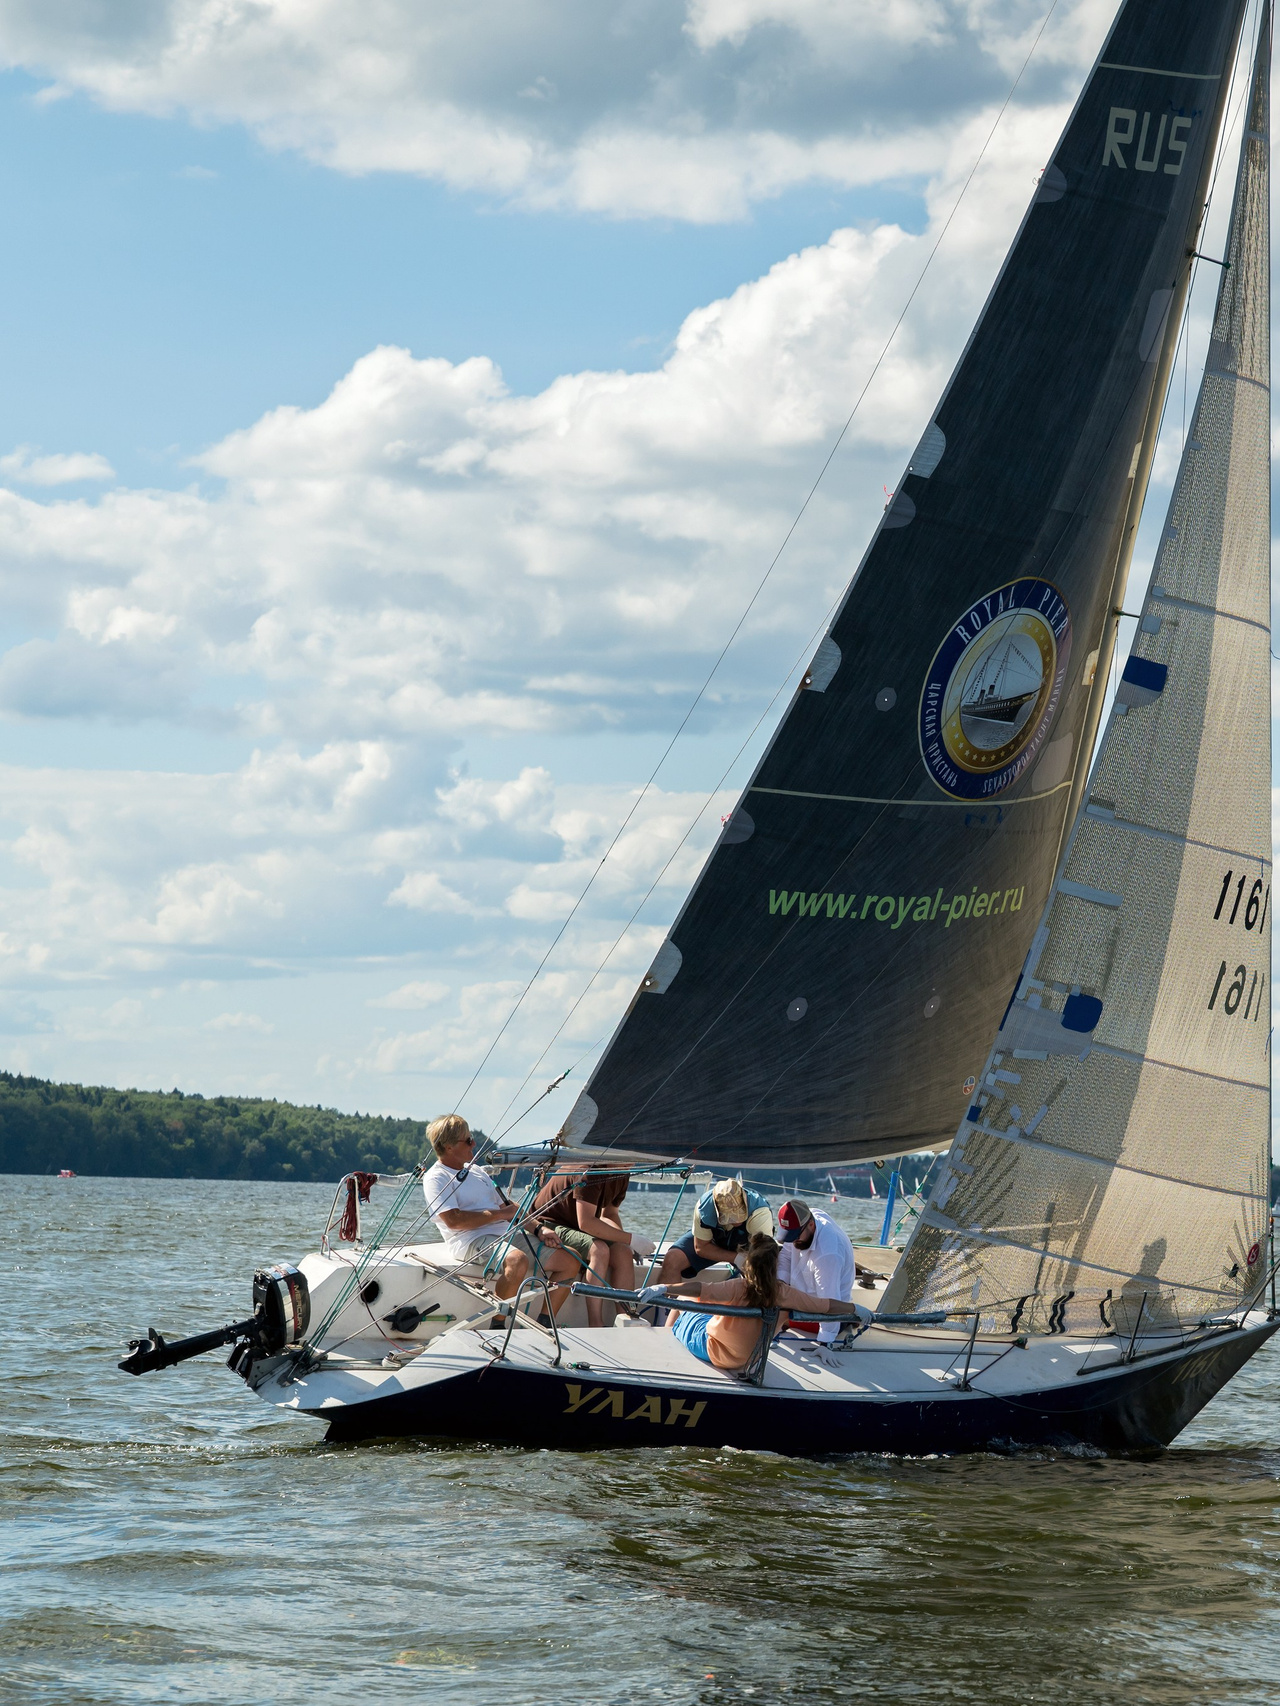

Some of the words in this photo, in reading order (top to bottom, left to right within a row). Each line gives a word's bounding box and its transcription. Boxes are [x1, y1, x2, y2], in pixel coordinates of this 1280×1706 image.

[1102, 106, 1192, 176] RUS
[954, 585, 1016, 645] ROYAL
[1037, 587, 1069, 638] PIER
[924, 682, 942, 738] ЦАРСКАЯ
[982, 752, 1031, 794] SEVASTOPOL
[1030, 715, 1050, 752] YACHT
[1047, 667, 1066, 713] MARINA
[927, 742, 959, 787] ПРИСТАНЬ
[768, 885, 1026, 930] www.royal-pier.ru
[1213, 869, 1271, 935] 1161
[293, 1284, 304, 1330] MERCURY
